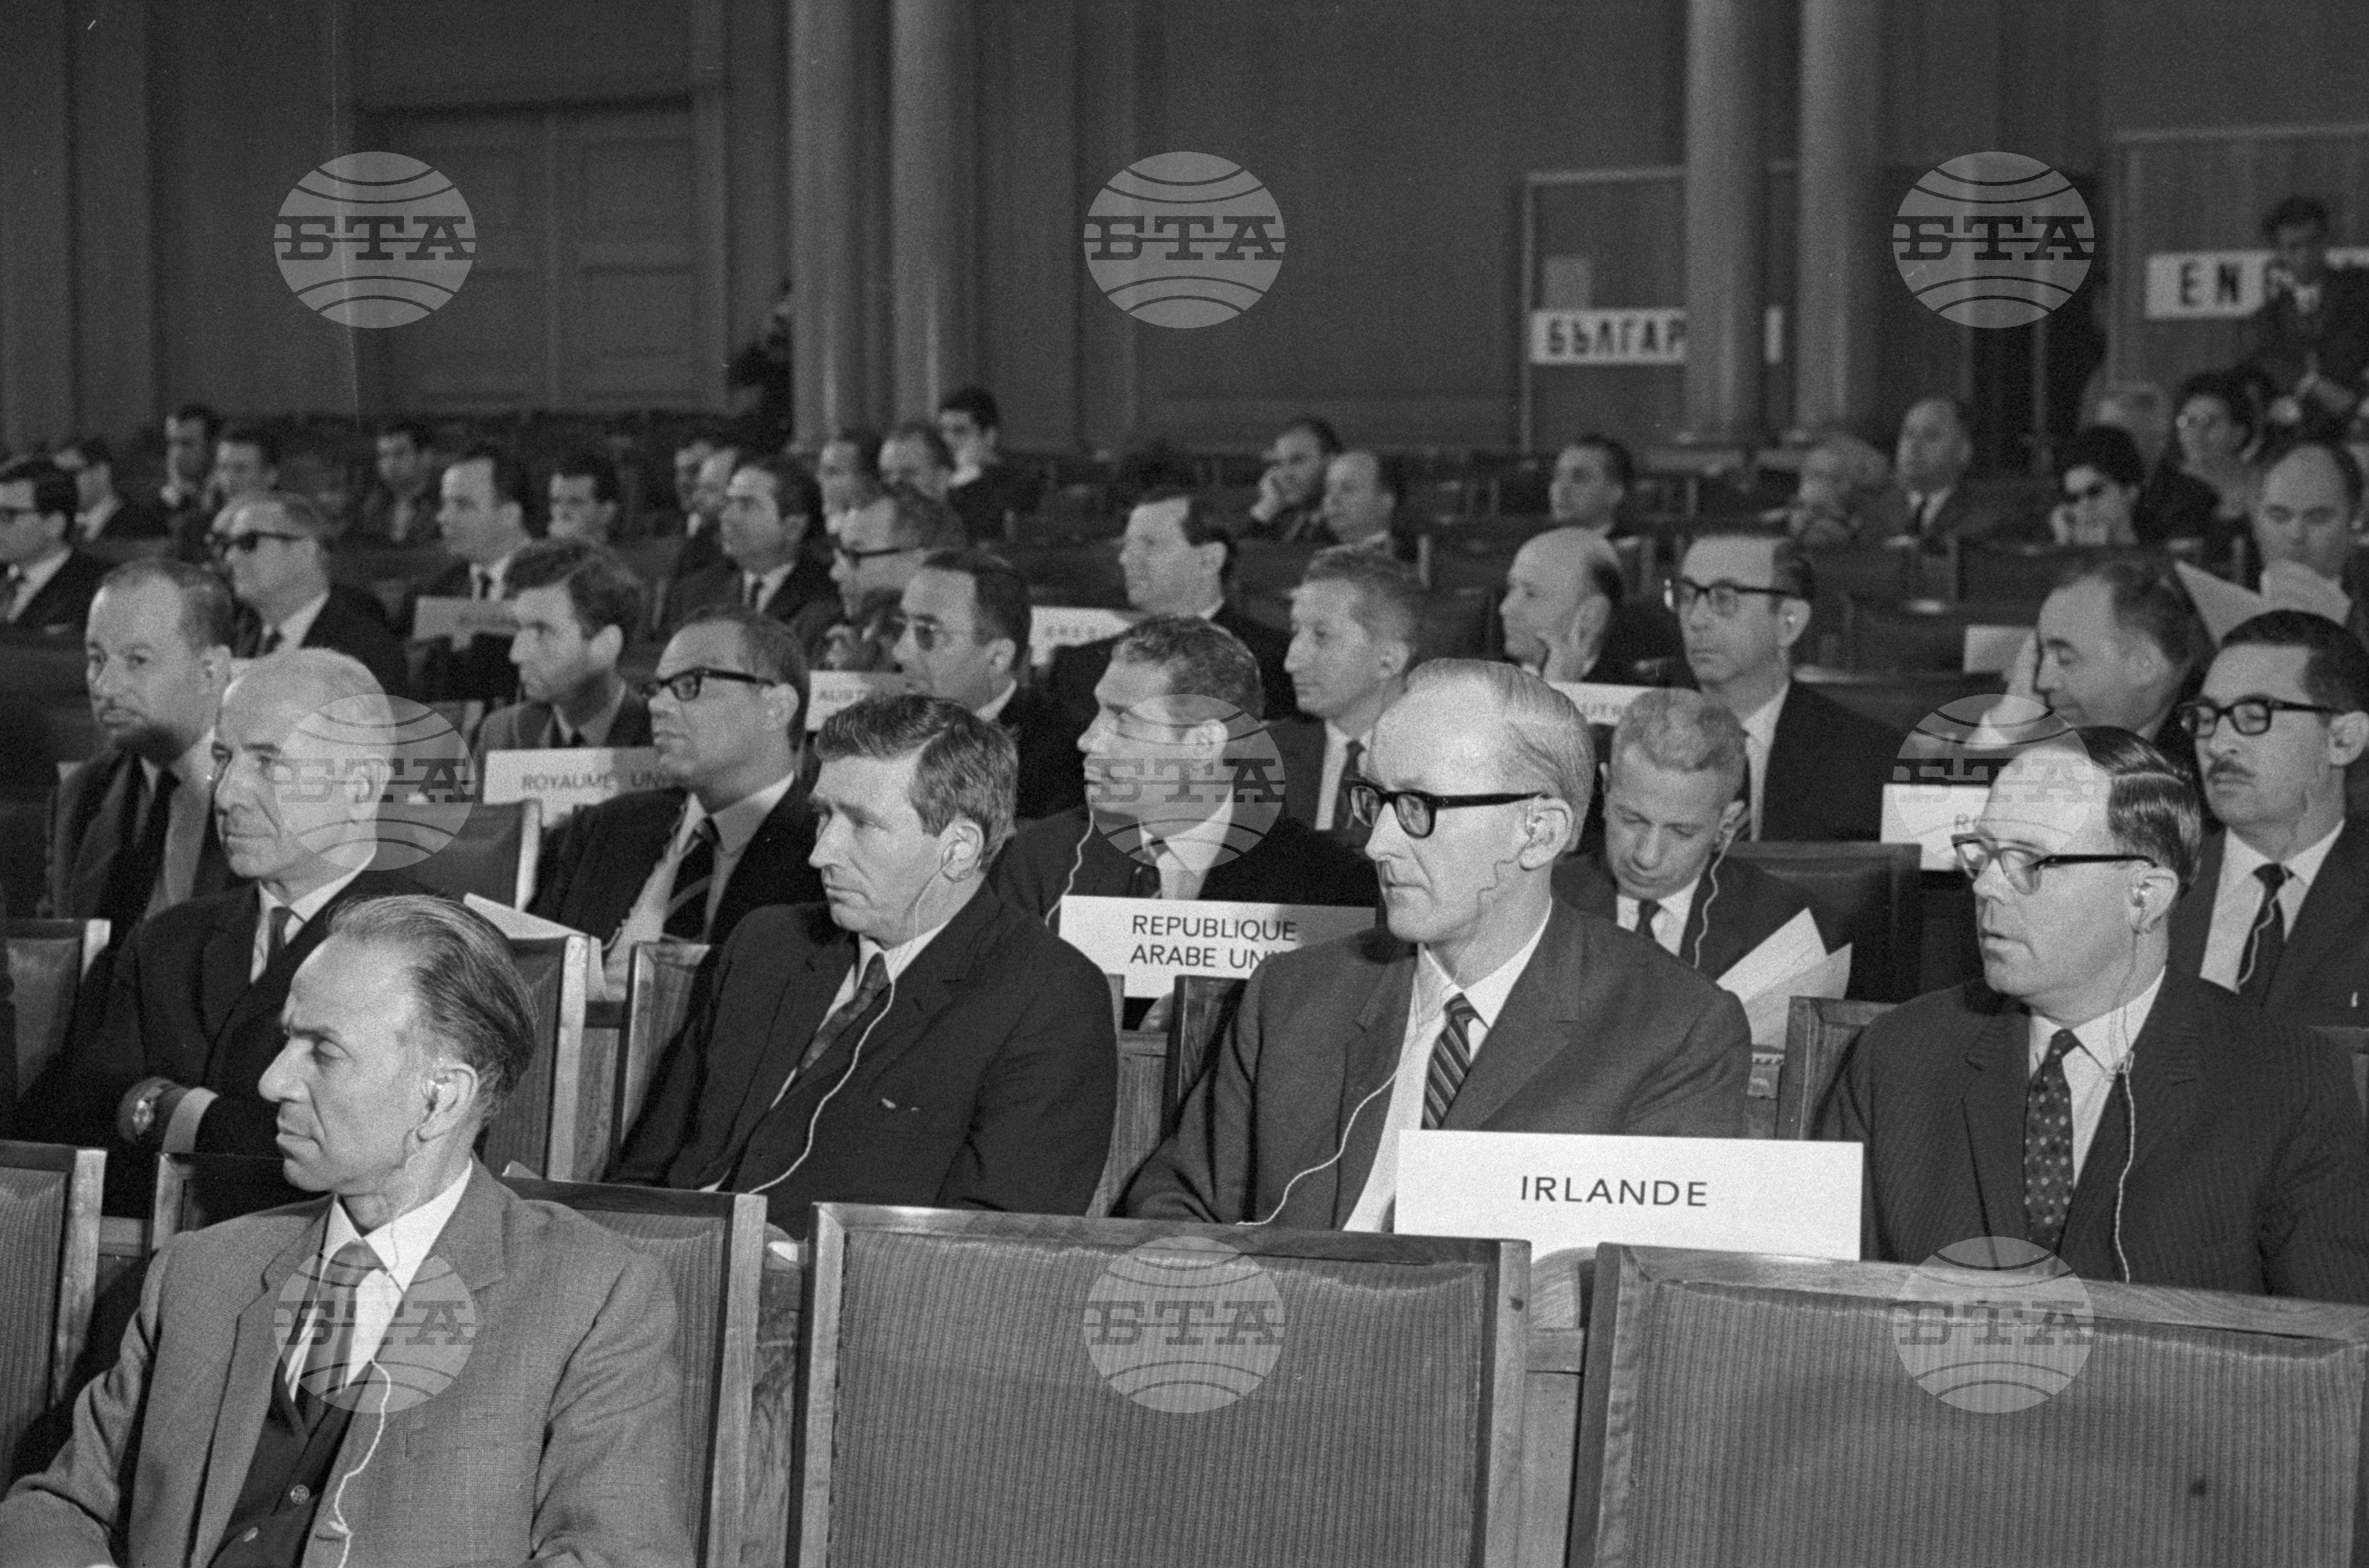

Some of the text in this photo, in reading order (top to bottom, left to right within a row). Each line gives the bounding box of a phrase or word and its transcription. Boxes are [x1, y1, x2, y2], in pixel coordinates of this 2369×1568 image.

[1132, 914, 1297, 942] REPUBLIQUE
[1129, 944, 1275, 970] ARABE UN
[1521, 1175, 1707, 1207] IRLANDE
